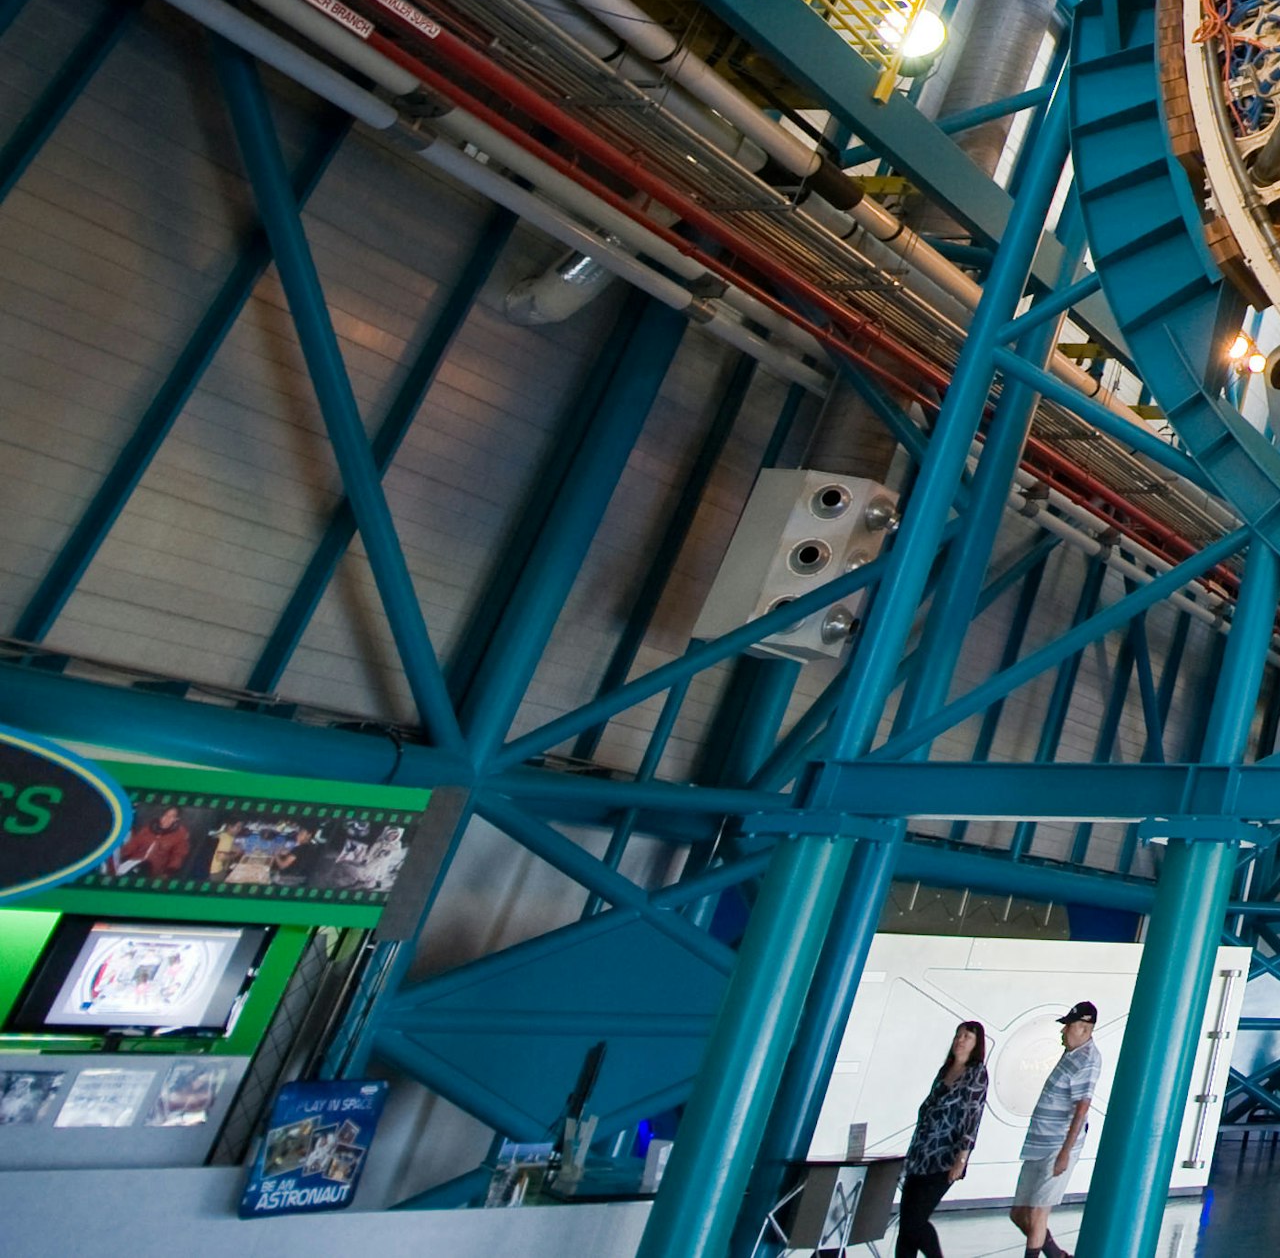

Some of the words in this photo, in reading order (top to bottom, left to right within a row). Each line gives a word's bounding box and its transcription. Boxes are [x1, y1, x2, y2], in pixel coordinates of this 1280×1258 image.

[331, 0, 372, 35] BRANCH
[409, 8, 439, 36] SUPPLY
[296, 1099, 327, 1113] PLAY
[326, 1098, 341, 1111] IN
[341, 1096, 374, 1112] SPACE
[254, 1184, 351, 1211] ASTRONAUT
[260, 1180, 278, 1193] BE
[277, 1178, 296, 1192] AN
